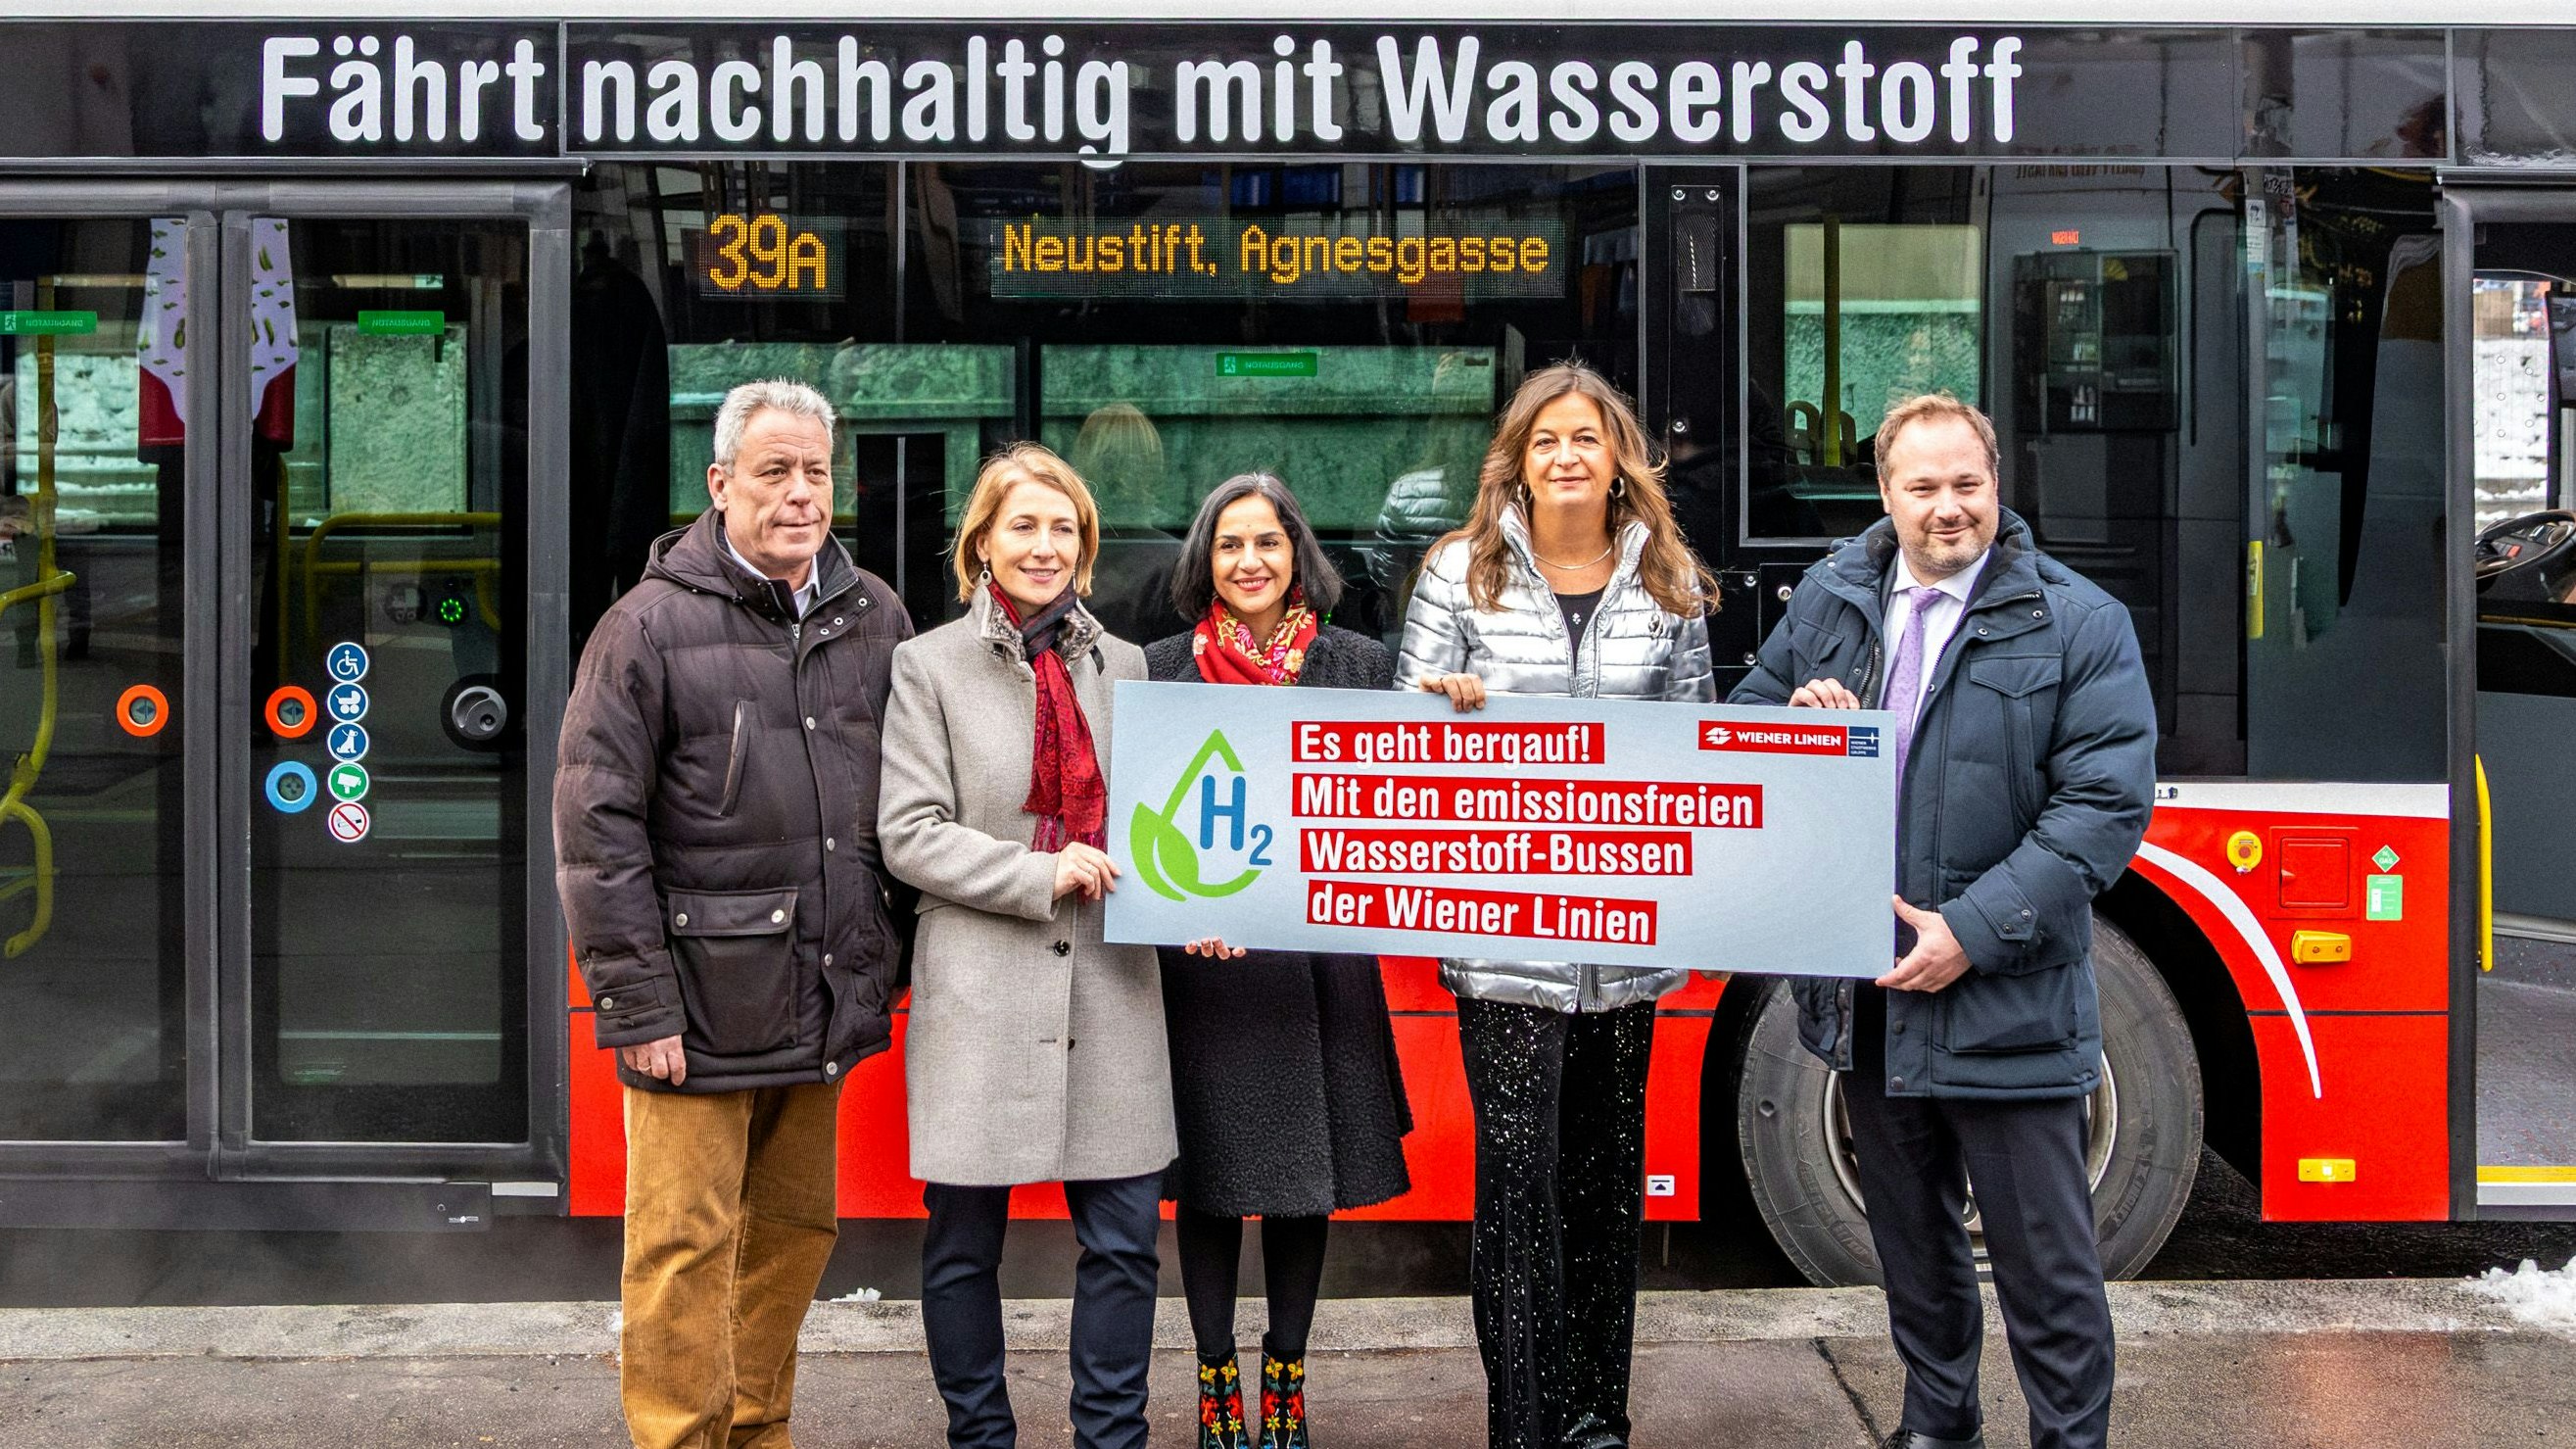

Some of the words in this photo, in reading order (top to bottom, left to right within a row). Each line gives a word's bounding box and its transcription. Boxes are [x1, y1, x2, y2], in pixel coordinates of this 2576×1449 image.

[262, 35, 546, 142] Fährt
[583, 35, 1129, 169] nachhaltig
[1176, 35, 1343, 142] mit
[1376, 36, 2023, 143] Wasserstoff
[709, 215, 827, 290] 39A
[1003, 224, 1217, 276] Neustift,
[1241, 224, 1549, 284] Agnesgasse
[1300, 723, 1342, 761] Es
[1354, 724, 1432, 770] geht
[1444, 724, 1591, 770] bergauf!
[1736, 731, 1791, 745] WIENER
[1794, 733, 1841, 747] LINIEN
[1301, 776, 1361, 817] Mit
[1373, 777, 1440, 818] den
[1454, 781, 1754, 827] emissionsfreien
[1307, 830, 1685, 875] Wasserstoff-Bussen
[1312, 883, 1374, 926] der
[1384, 887, 1520, 935] Wiener
[1533, 895, 1650, 943] Linien
